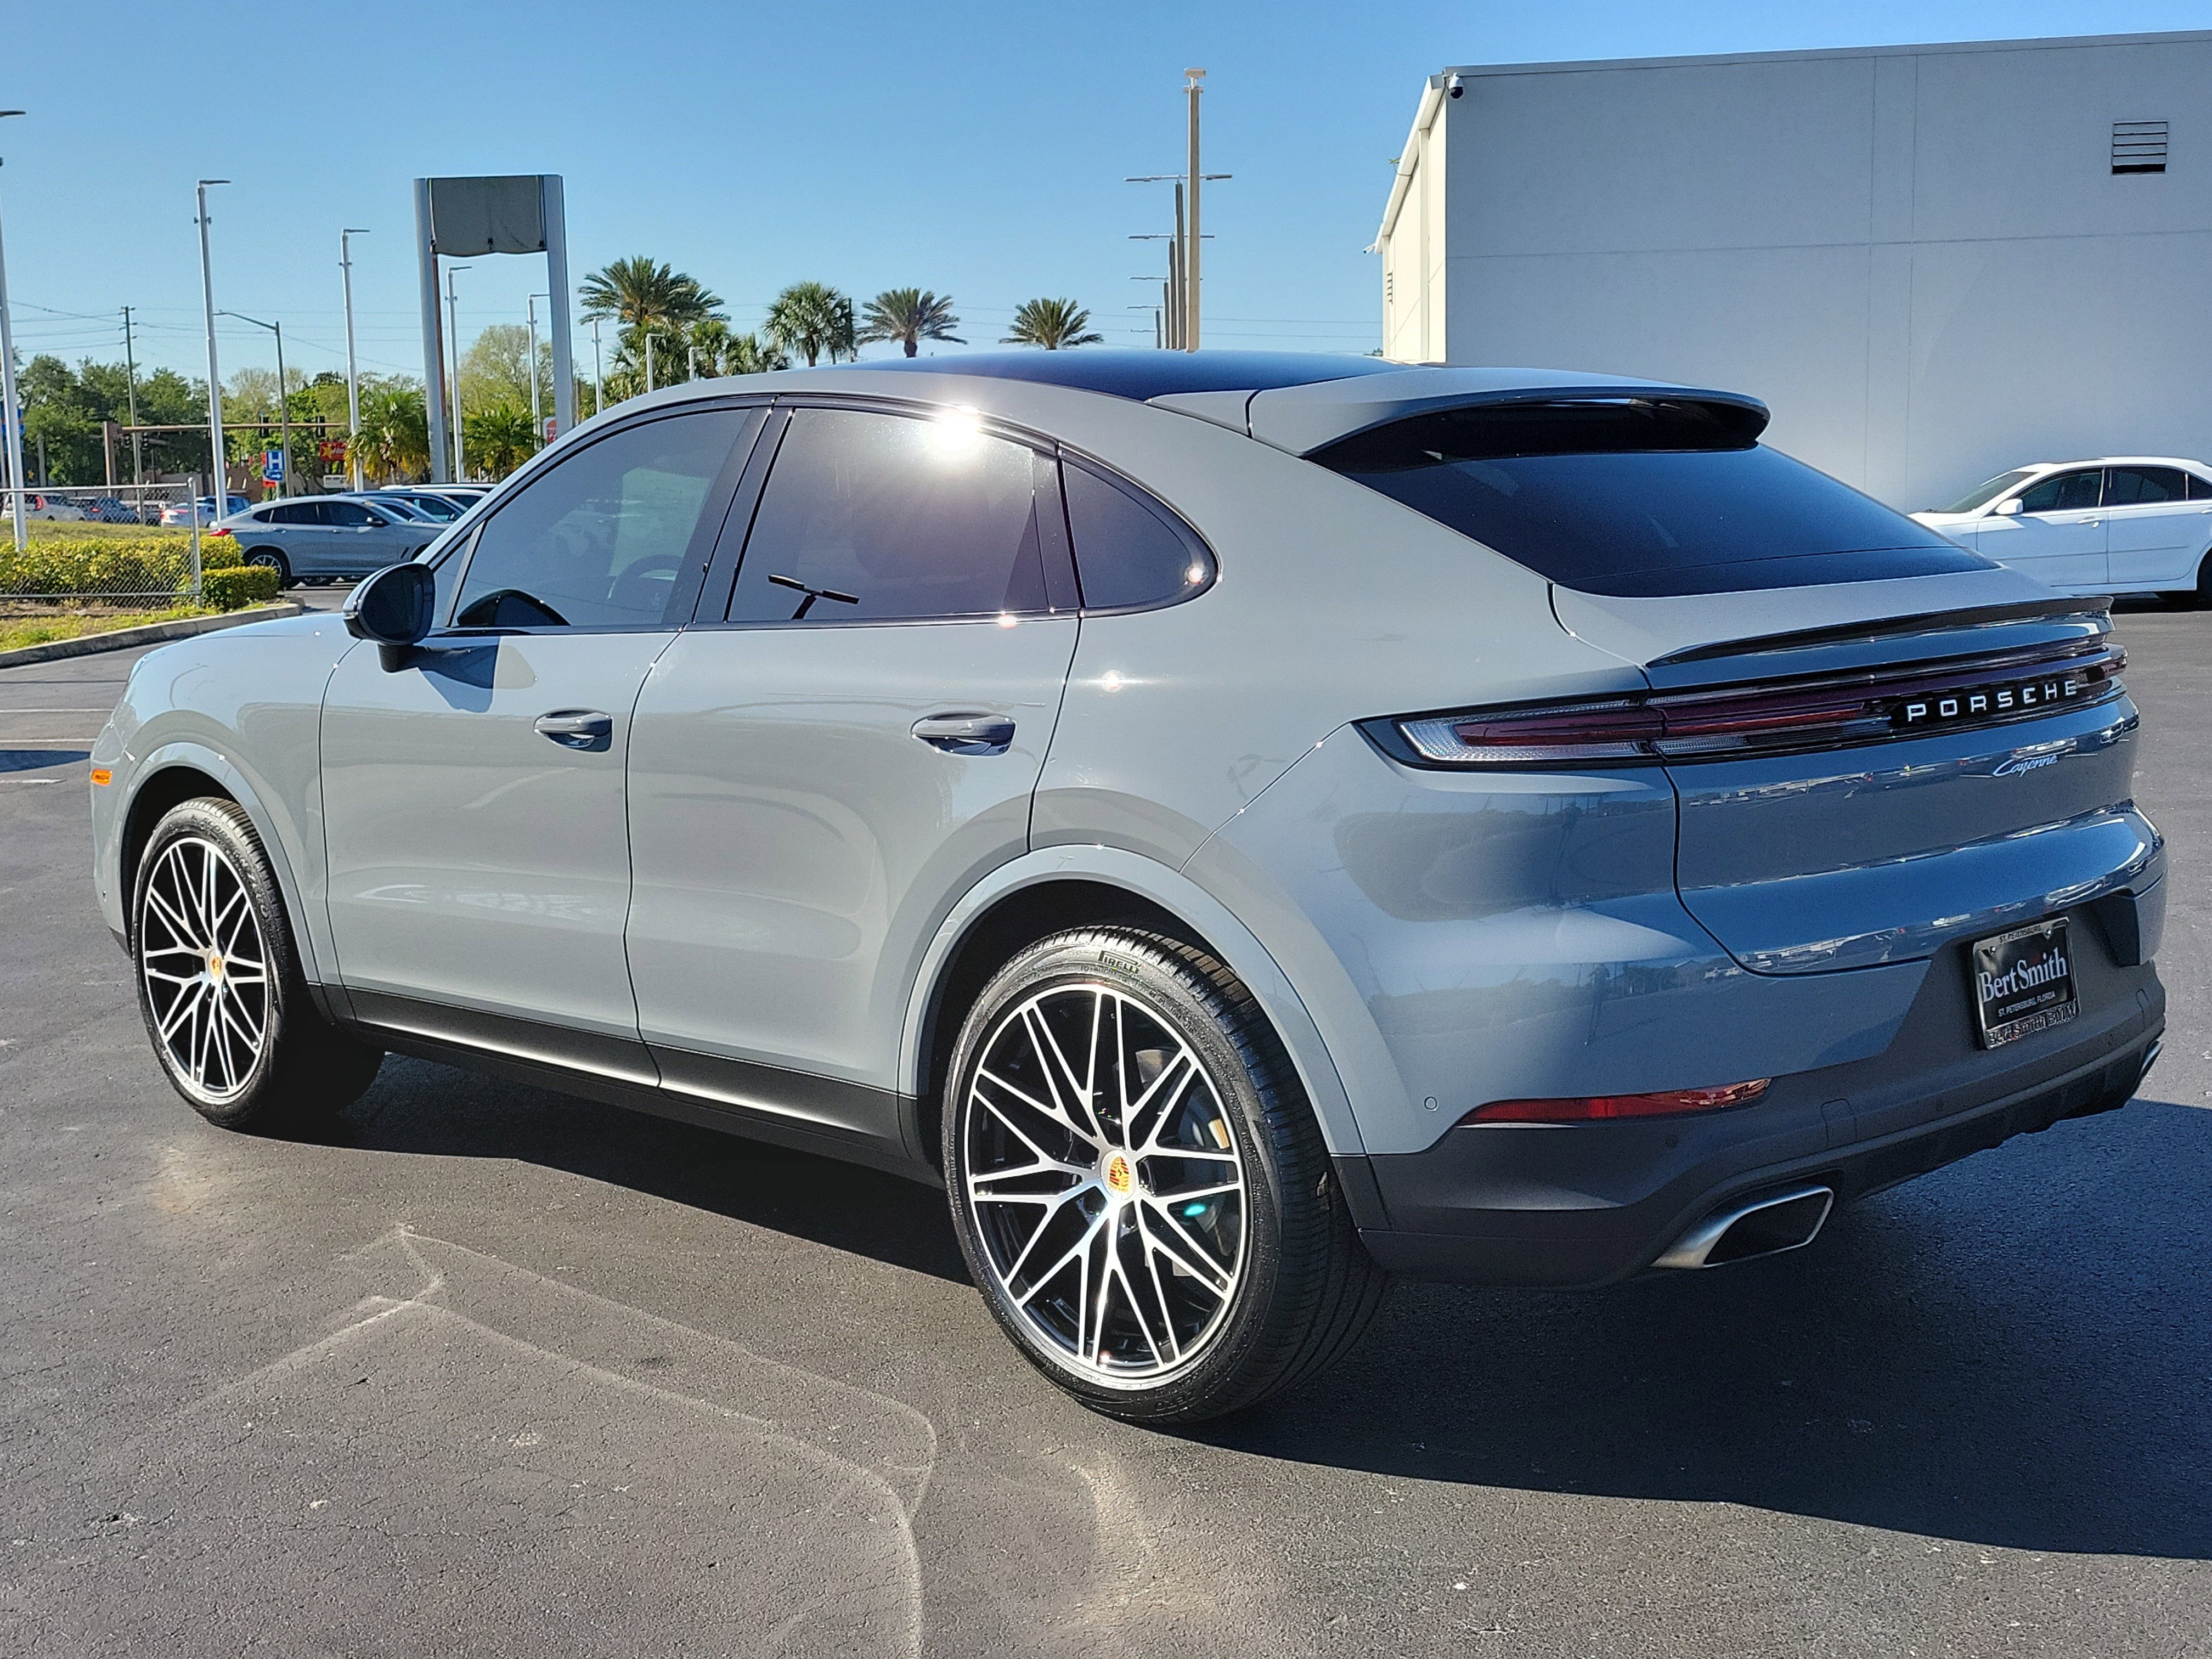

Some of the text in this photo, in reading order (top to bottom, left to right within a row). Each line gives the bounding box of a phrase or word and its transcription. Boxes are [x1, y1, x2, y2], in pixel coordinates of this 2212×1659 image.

[268, 452, 283, 470] H
[1906, 680, 2077, 722] PORSCHE
[1993, 754, 2058, 777] Cayenne
[1098, 950, 1142, 974] PIRELLI
